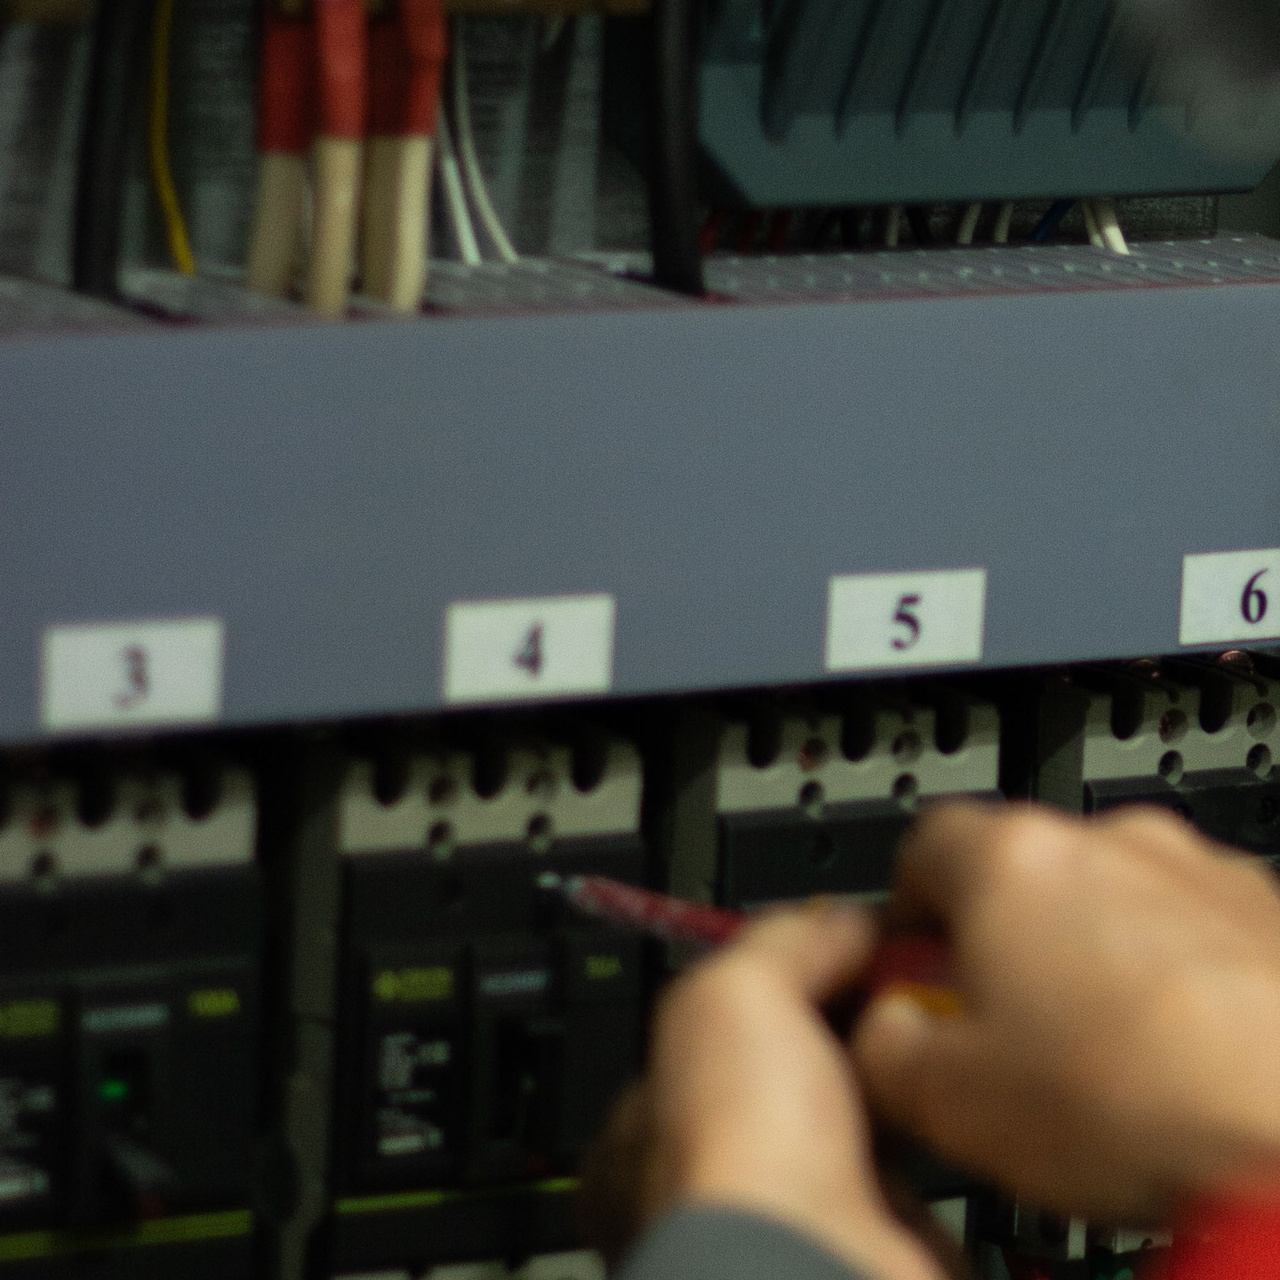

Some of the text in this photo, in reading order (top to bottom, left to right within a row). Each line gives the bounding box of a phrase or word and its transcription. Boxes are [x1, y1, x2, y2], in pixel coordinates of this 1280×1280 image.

[889, 593, 922, 650] 5
[1239, 567, 1270, 625] 6
[112, 644, 149, 708] 3
[512, 622, 544, 680] 4
